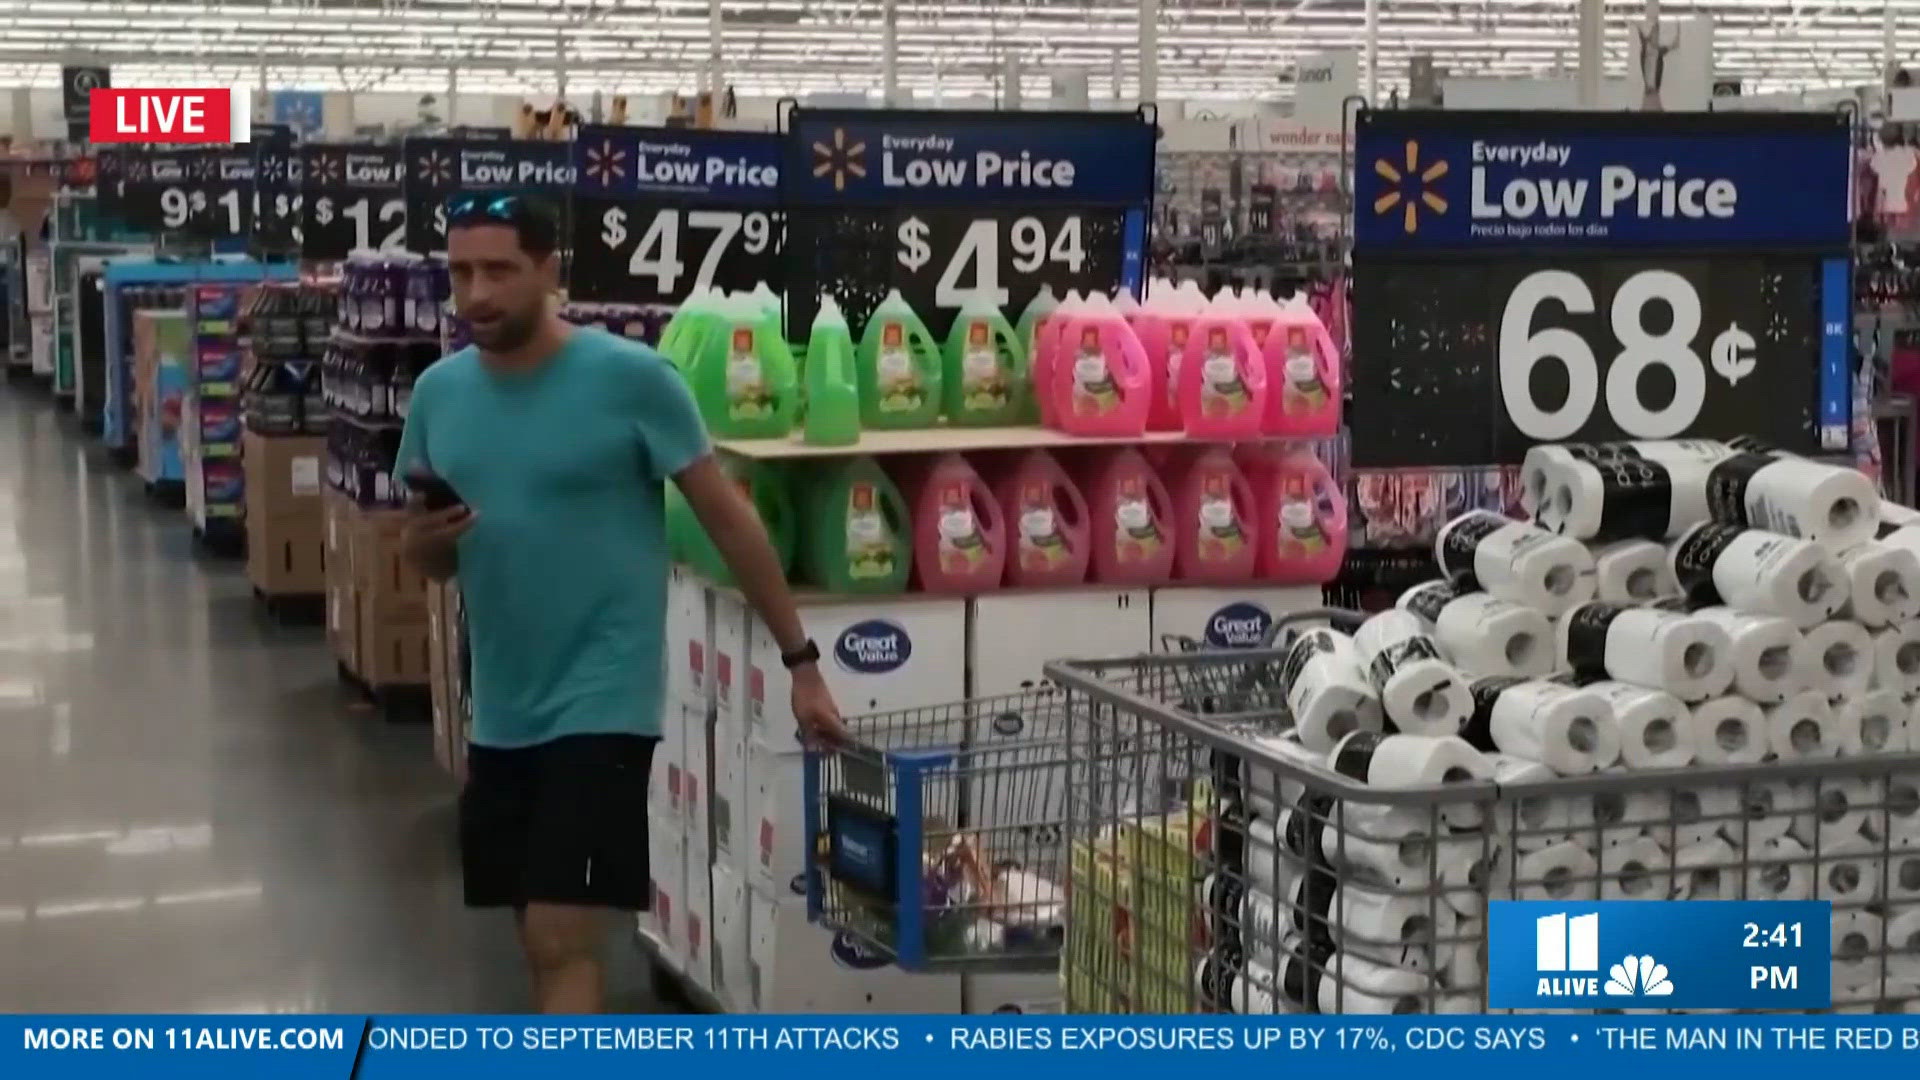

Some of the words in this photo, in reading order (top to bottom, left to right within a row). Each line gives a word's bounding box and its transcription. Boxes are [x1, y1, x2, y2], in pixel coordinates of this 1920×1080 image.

[882, 133, 955, 153] Everyday
[1269, 125, 1321, 146] wonder
[638, 140, 692, 157] Everyday
[1470, 140, 1572, 167] Everyday
[345, 160, 391, 181] Low
[460, 159, 514, 184] Low
[636, 154, 700, 183] Low
[705, 156, 780, 187] Price
[882, 151, 968, 187] Low
[975, 150, 1076, 188] Price
[1470, 165, 1589, 220] Low
[1600, 162, 1738, 219] Price
[1470, 223, 1505, 237] Precio
[1506, 223, 1532, 239] bajo
[1533, 223, 1566, 237] todos
[1567, 223, 1584, 237] los
[1213, 615, 1262, 635] Great
[844, 632, 898, 652] Great
[858, 649, 899, 663] Value
